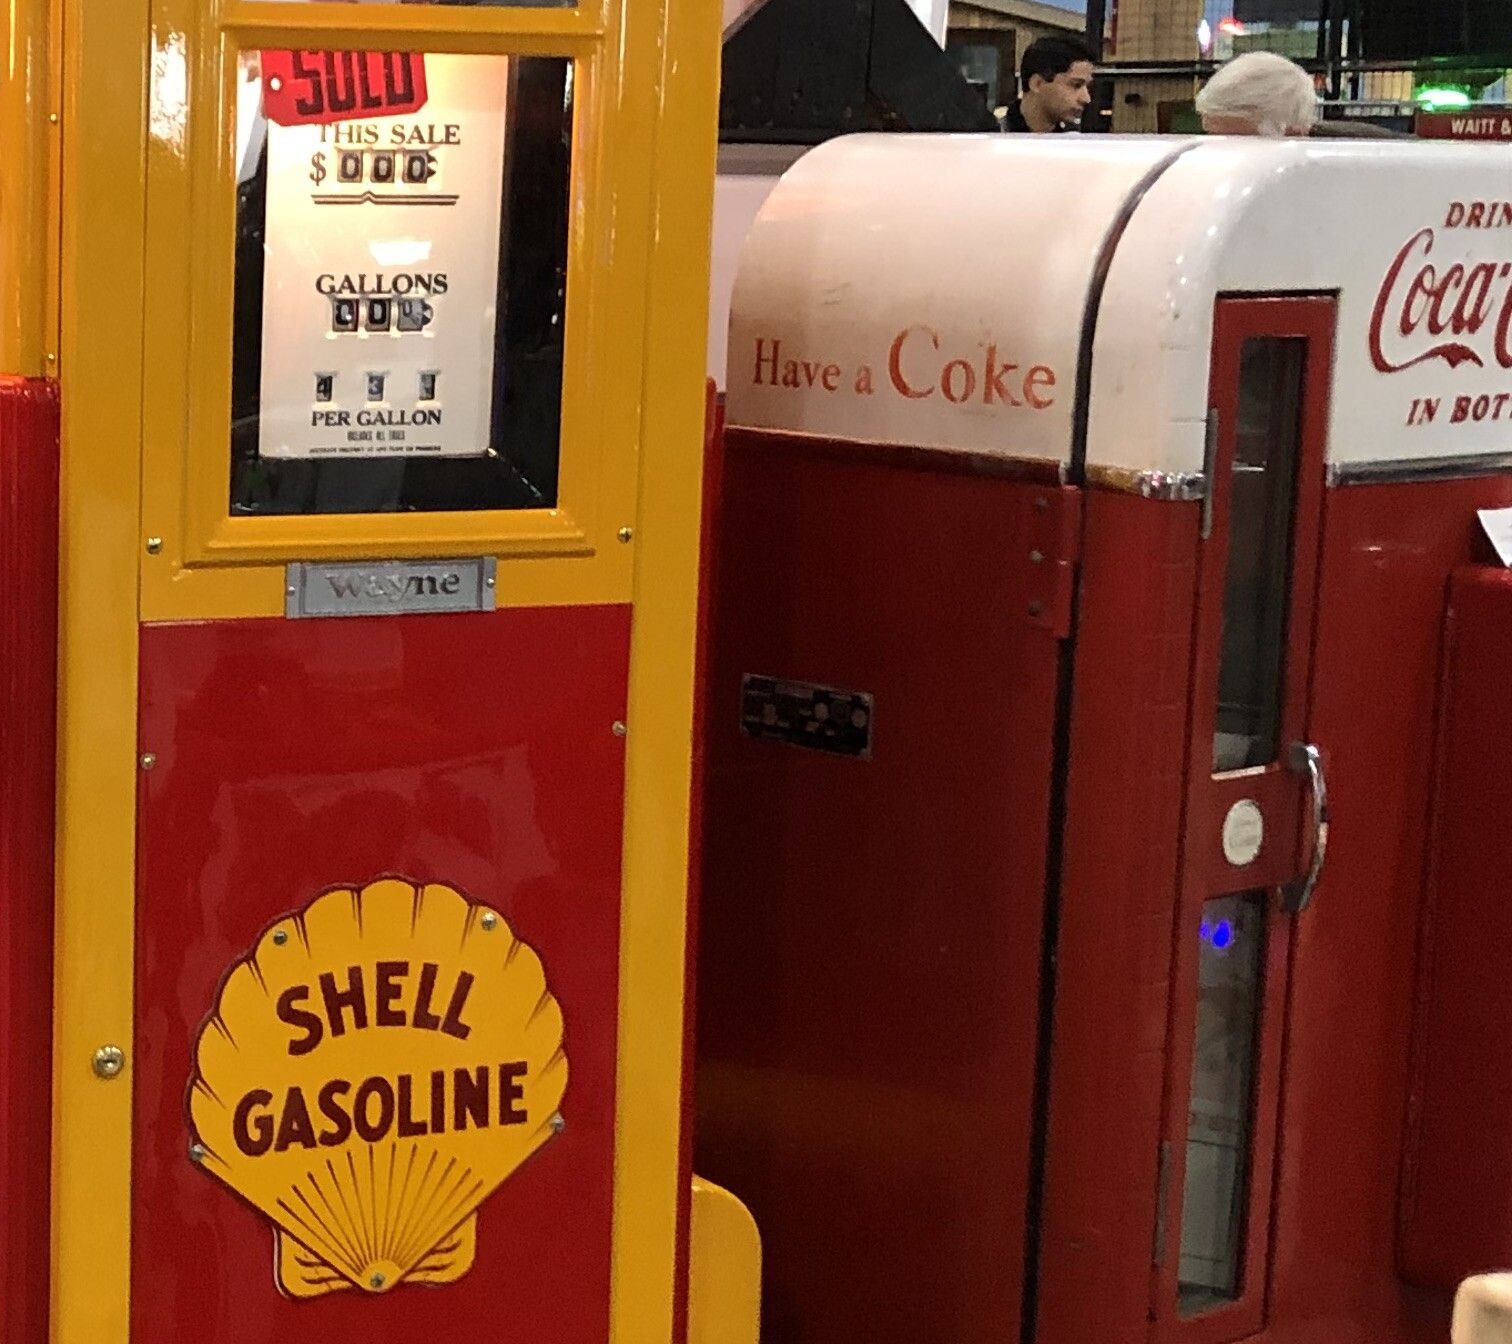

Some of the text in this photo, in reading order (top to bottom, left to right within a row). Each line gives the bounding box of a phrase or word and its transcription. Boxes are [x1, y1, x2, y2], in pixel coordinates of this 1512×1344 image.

[292, 50, 415, 116] SOLD
[315, 123, 461, 145] THIS SALE
[315, 272, 448, 295] GALLONS
[751, 325, 1057, 412] Have a Coke
[311, 408, 442, 427] PER GALLON
[1406, 393, 1512, 426] IN BOT
[274, 959, 478, 1056] SHELL
[231, 1058, 530, 1160] GASOLINE
